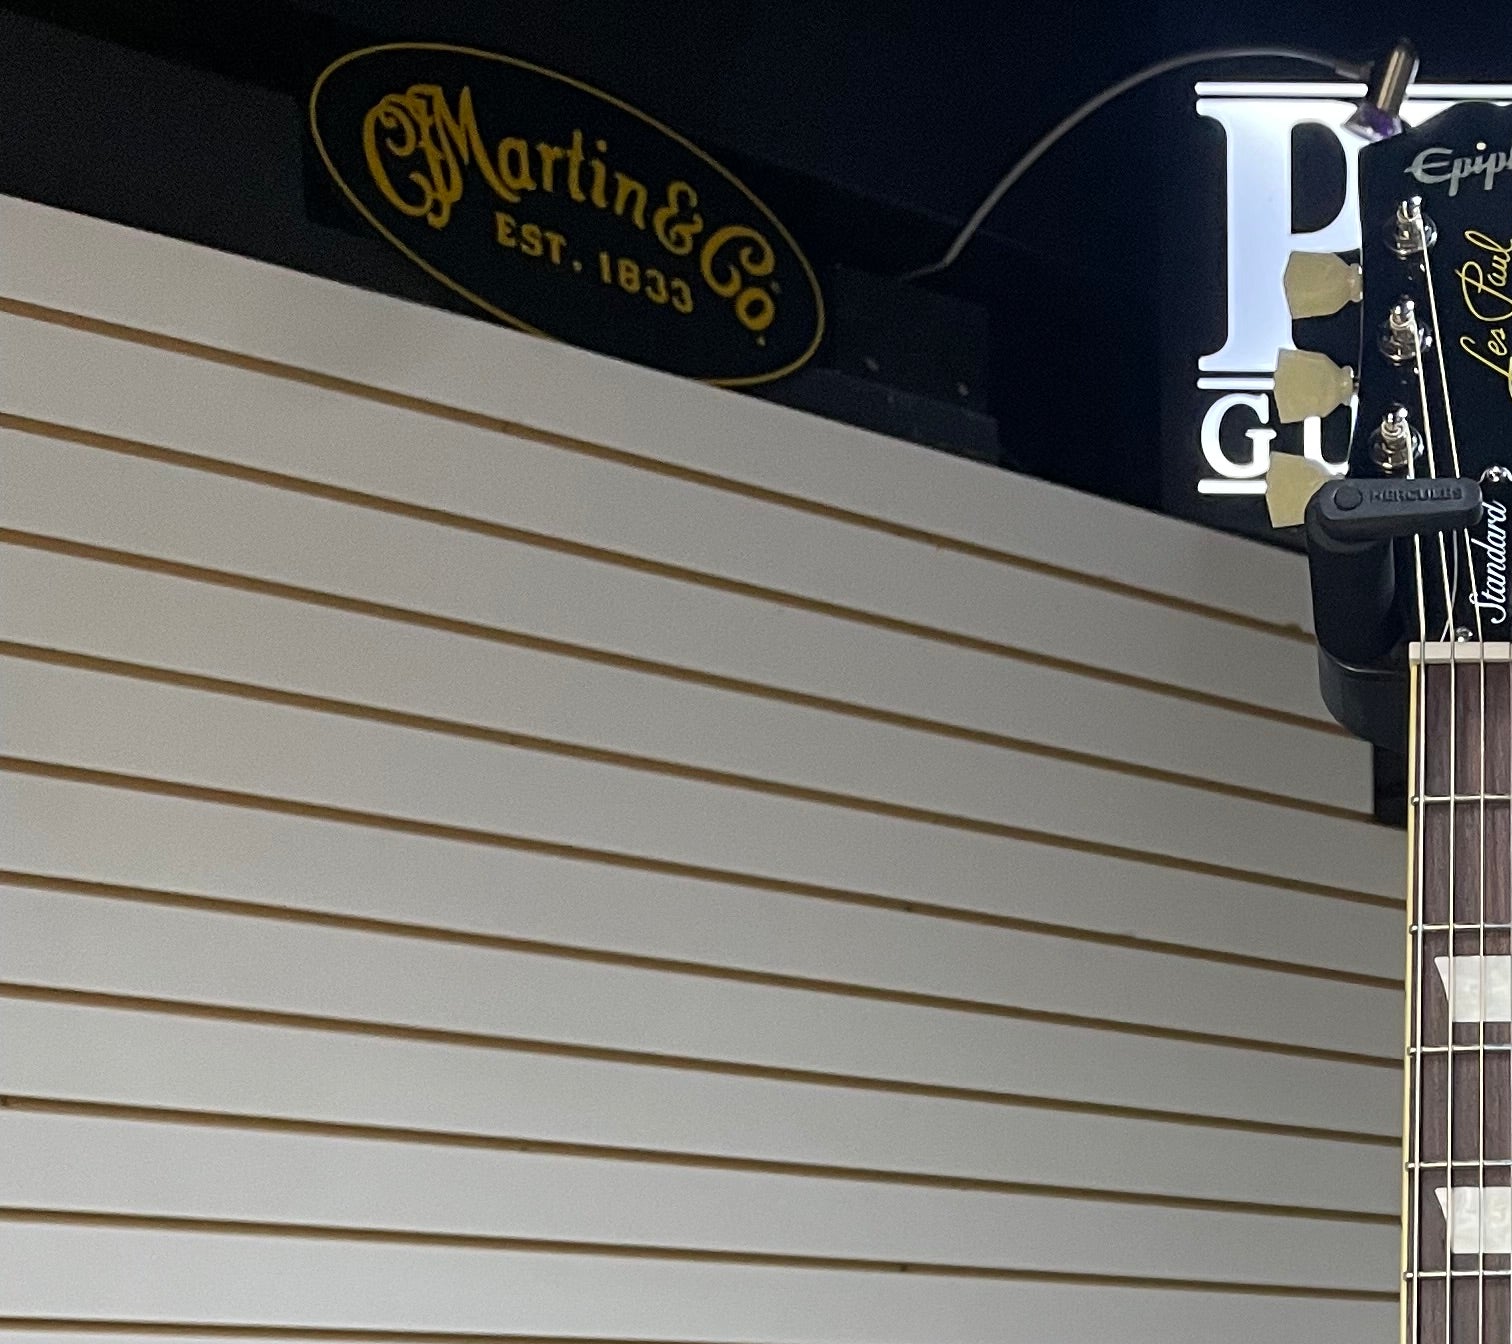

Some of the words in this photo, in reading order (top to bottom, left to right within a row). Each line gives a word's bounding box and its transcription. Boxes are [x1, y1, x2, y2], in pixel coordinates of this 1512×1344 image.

[495, 210, 583, 272] EST.
[601, 250, 695, 315] 1833
[1468, 498, 1508, 625] Standard
